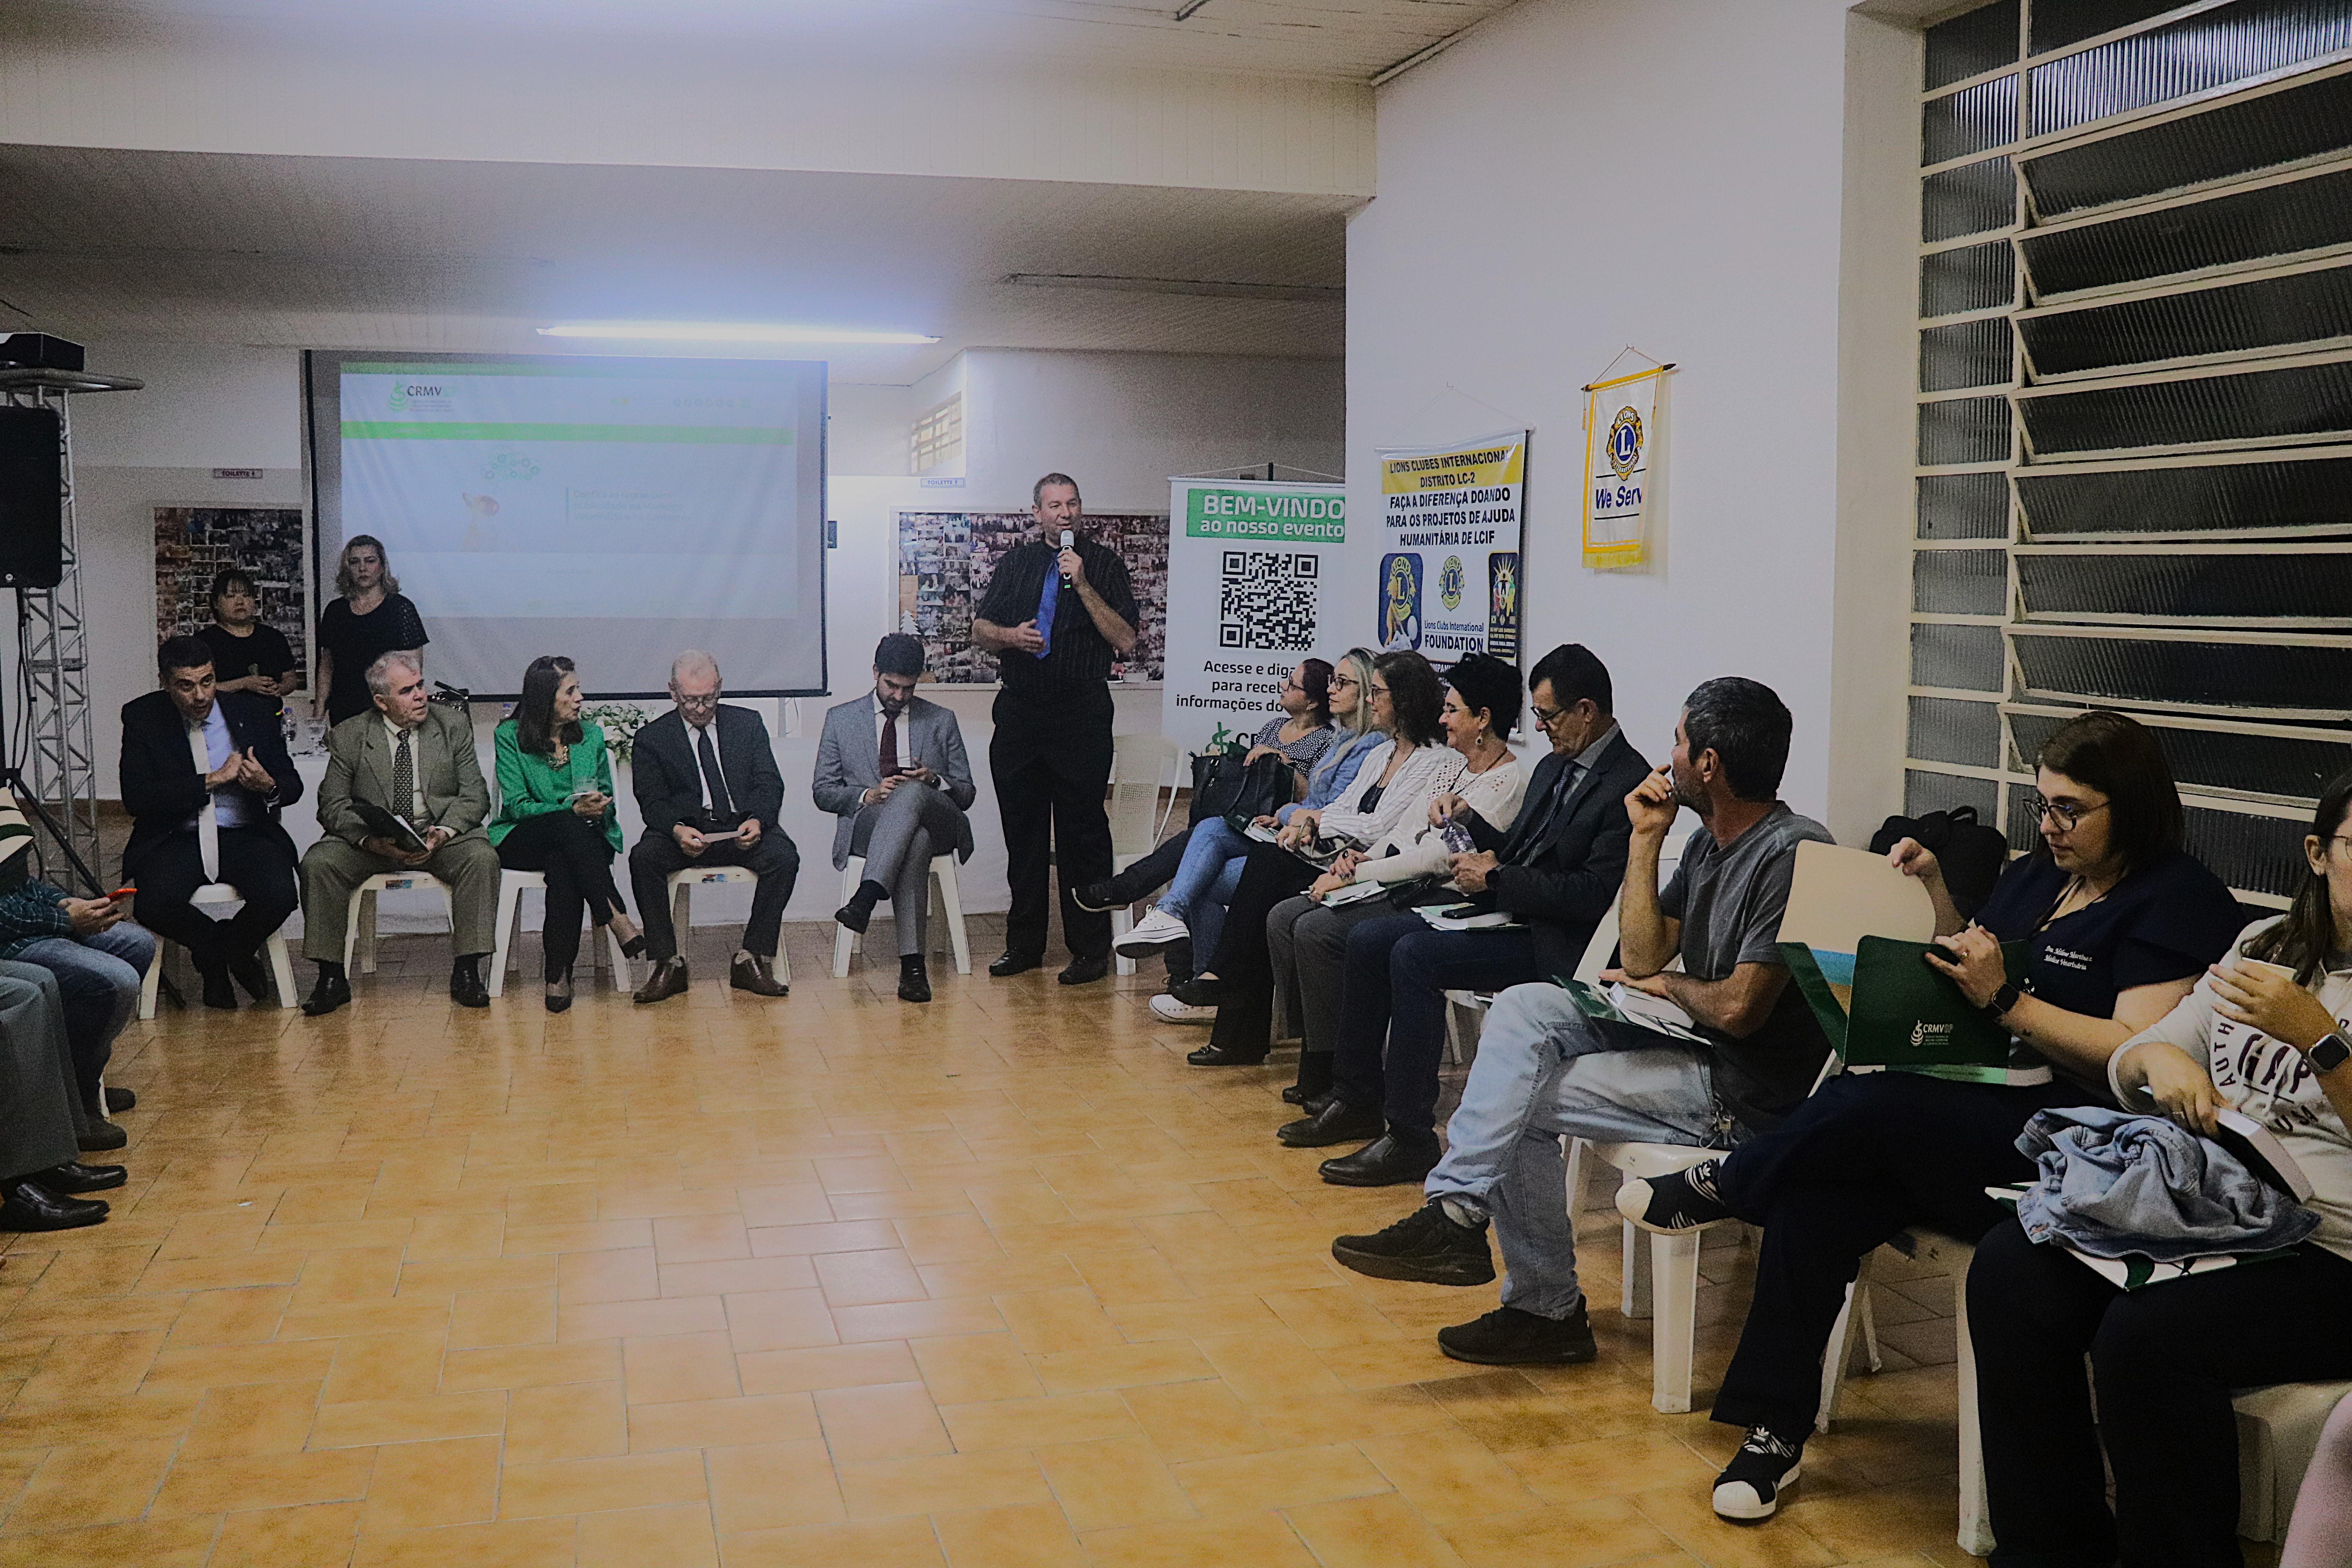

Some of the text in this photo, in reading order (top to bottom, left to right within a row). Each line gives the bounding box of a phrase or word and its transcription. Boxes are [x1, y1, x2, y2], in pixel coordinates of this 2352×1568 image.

[1617, 410, 1635, 425] LIONS
[1619, 429, 1631, 456] L
[1390, 450, 1509, 474] LIONS CLUBES INTERNACIONA
[1420, 472, 1475, 488] DISTRITO LC-2
[1203, 495, 1345, 519] BEM-VINDO
[1390, 487, 1510, 511] FAÇA A DIFERENÇA DOANDO
[1596, 488, 1612, 509] We
[1387, 508, 1515, 528] PARA OS PROJETOS DE AJUDA
[1200, 519, 1345, 537] ao nosso evento
[1400, 529, 1495, 546] HUMANITÁRIA DE LCIF
[1393, 558, 1410, 572] LIONS
[1446, 558, 1460, 569] LIONS
[1425, 620, 1436, 629] Lions
[1437, 621, 1448, 630] Clubs
[1450, 622, 1484, 632] International
[1425, 634, 1483, 652] FOUNDATION
[1204, 661, 1252, 674] Acesse
[1256, 666, 1263, 675] e
[1212, 681, 1242, 693] para
[1176, 694, 1262, 712] informações
